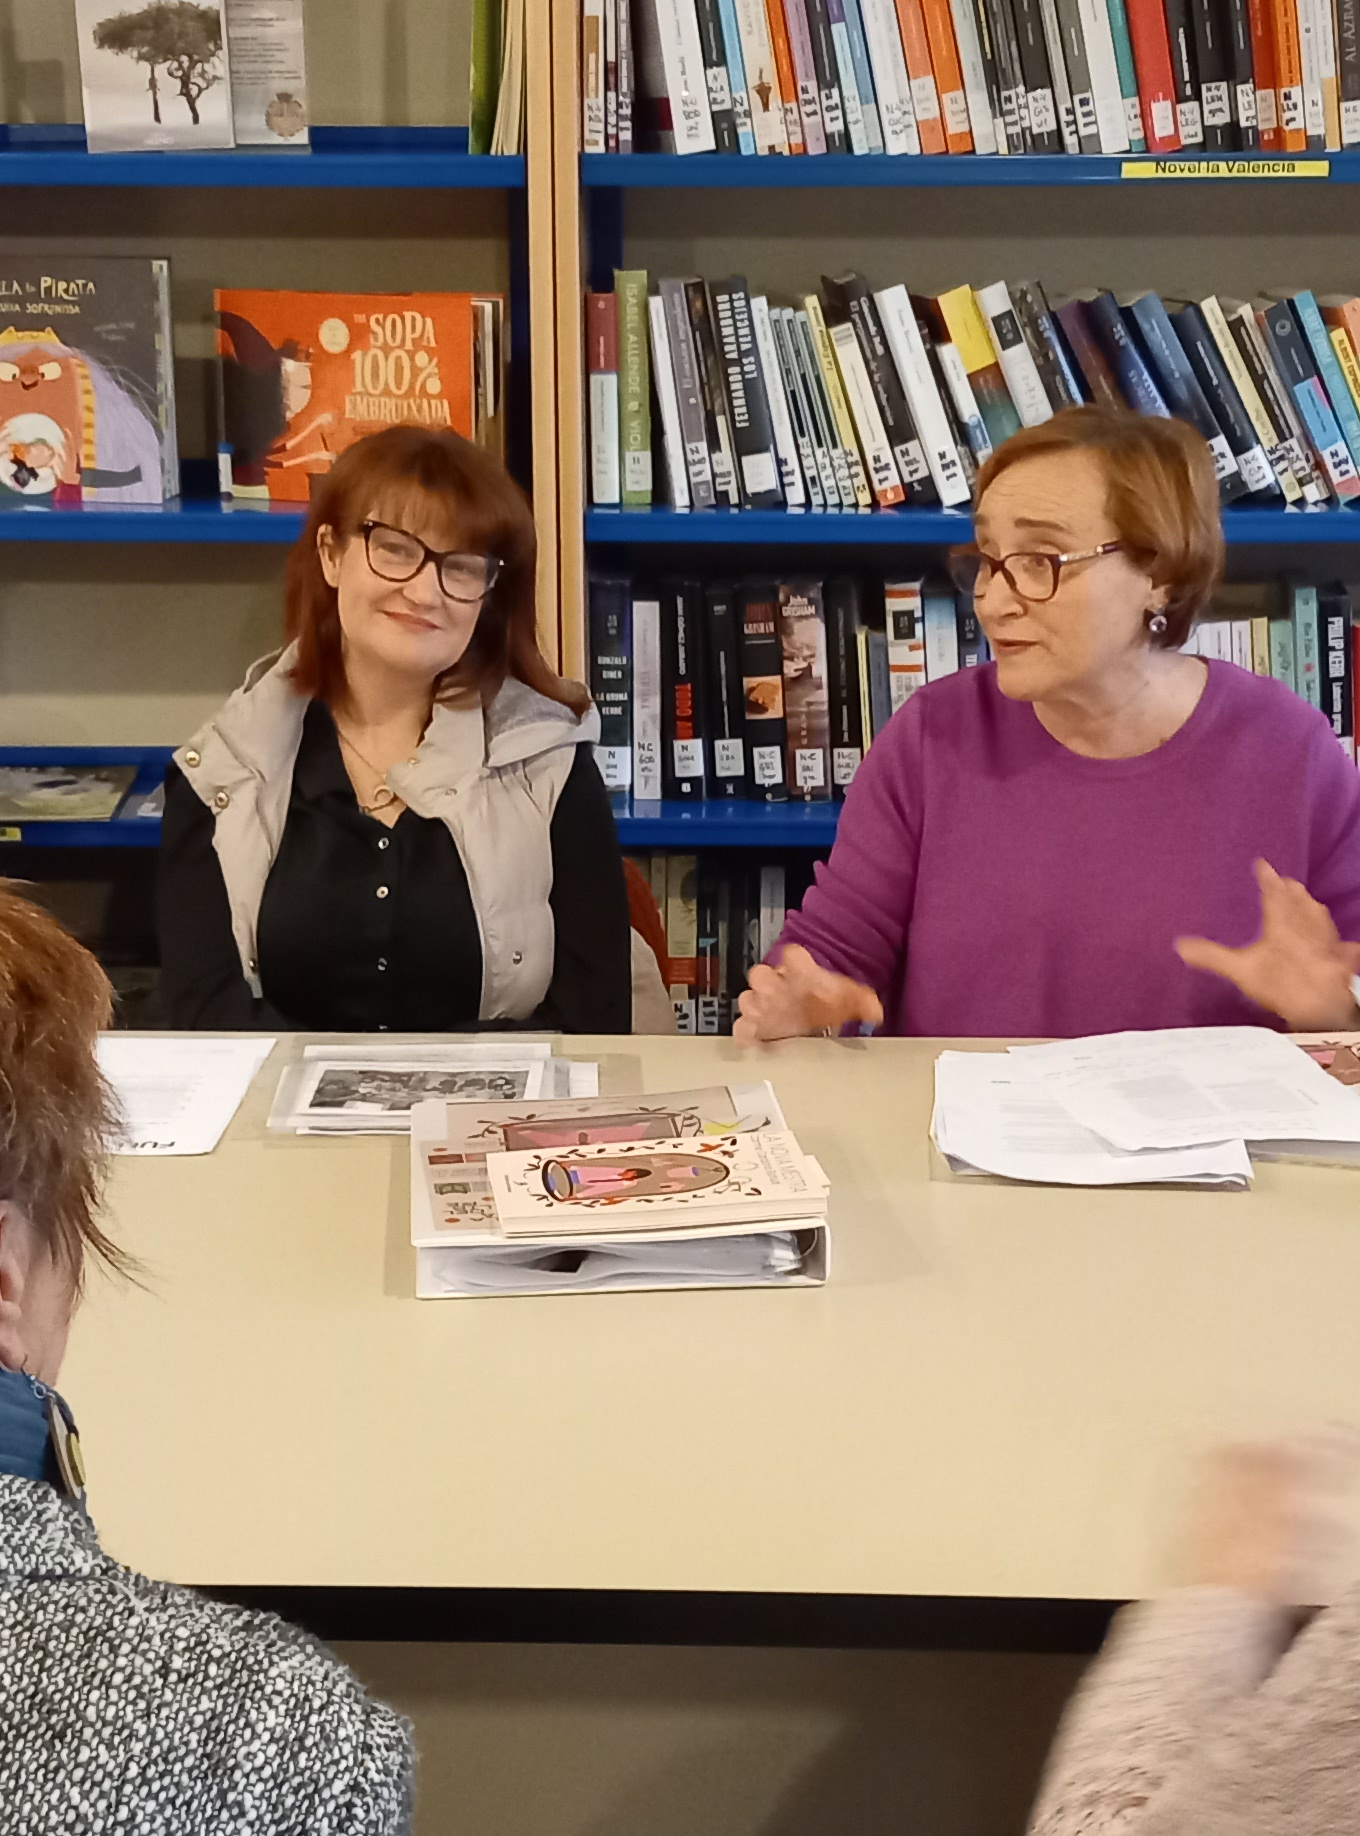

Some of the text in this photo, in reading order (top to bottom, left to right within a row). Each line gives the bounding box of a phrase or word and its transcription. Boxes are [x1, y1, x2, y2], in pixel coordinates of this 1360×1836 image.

[369, 311, 438, 350] SOPA
[351, 347, 441, 396] 100%
[626, 333, 640, 394] ALLENDE
[727, 366, 749, 428] FERNANDO
[629, 421, 641, 452] VIOL
